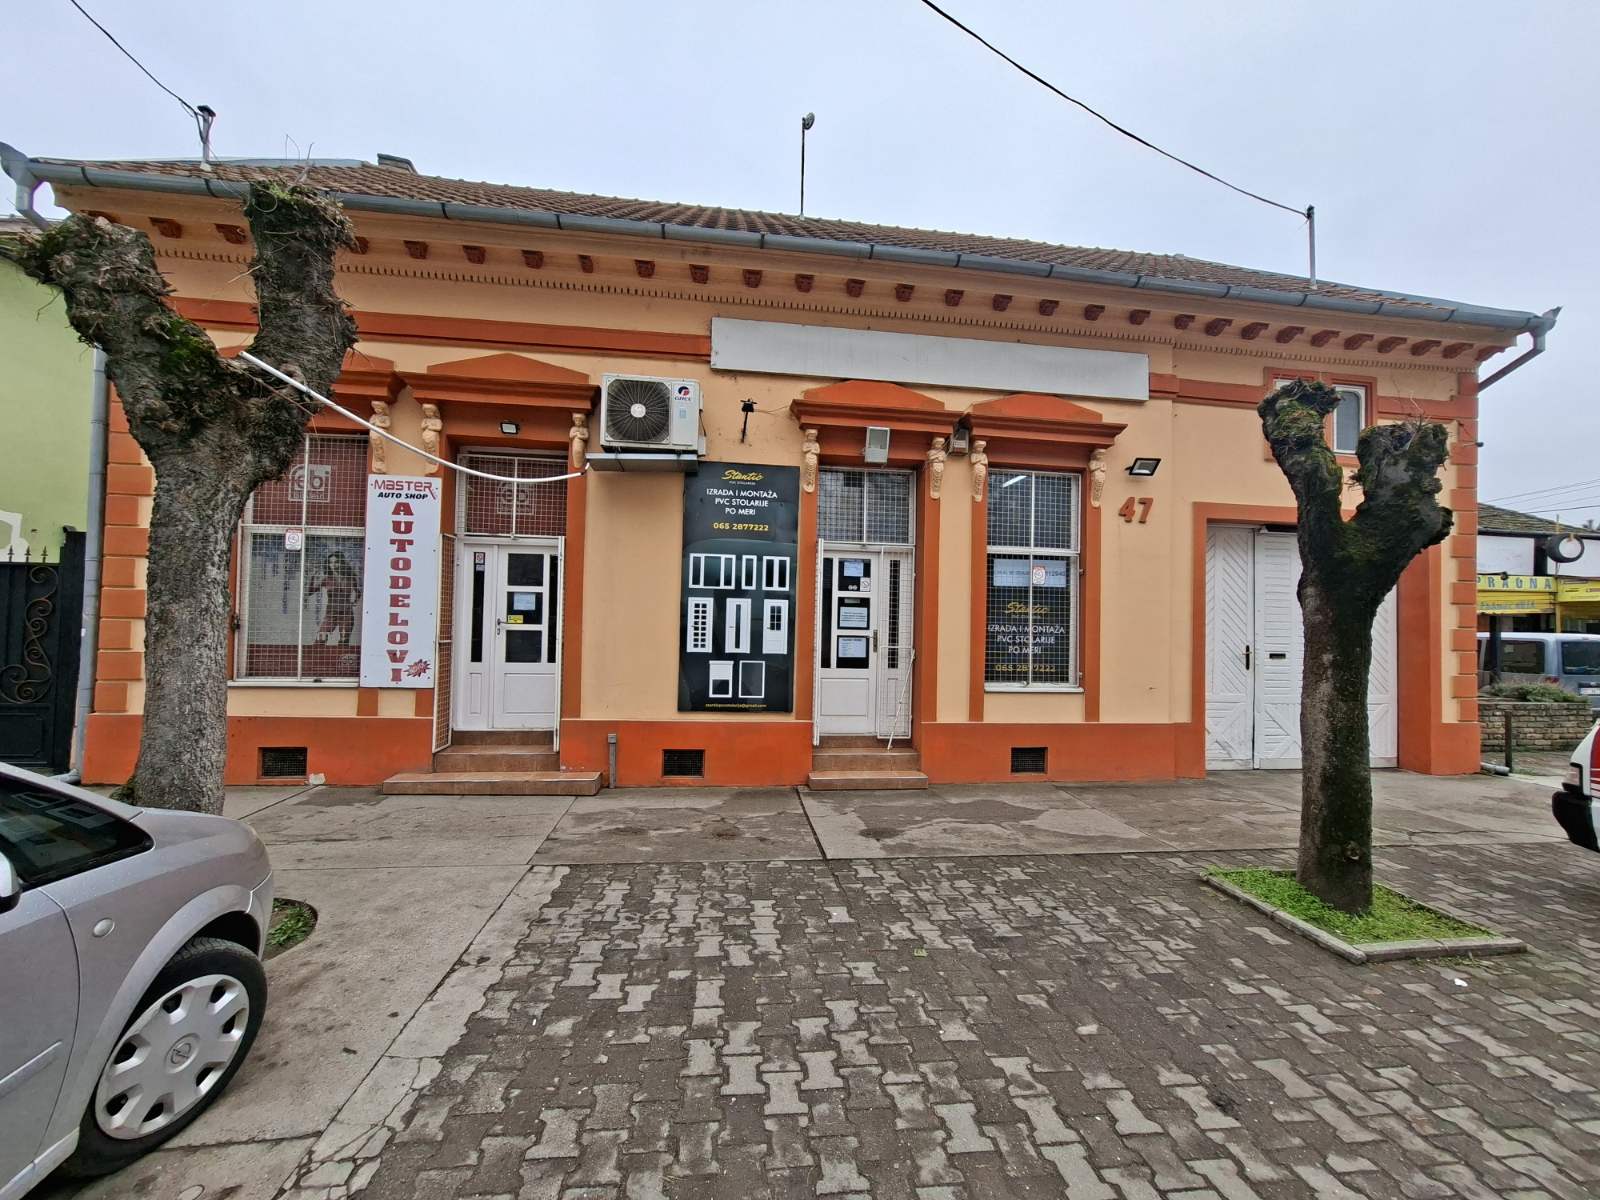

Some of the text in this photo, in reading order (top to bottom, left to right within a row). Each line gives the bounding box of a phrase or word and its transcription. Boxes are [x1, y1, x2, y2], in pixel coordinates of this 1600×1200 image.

[404, 492, 429, 500] SHOP
[706, 488, 734, 496] IZRADA
[740, 489, 778, 499] MONTAŽA
[715, 498, 769, 507] PVC STOLARIJE
[738, 508, 756, 516] MERI
[1118, 497, 1153, 524] 47
[713, 522, 769, 531] 065 2877222
[385, 502, 414, 682] AUTODELOVI
[988, 624, 1017, 633] IZRADA
[997, 635, 1013, 643] PVC
[1008, 645, 1020, 654] PO
